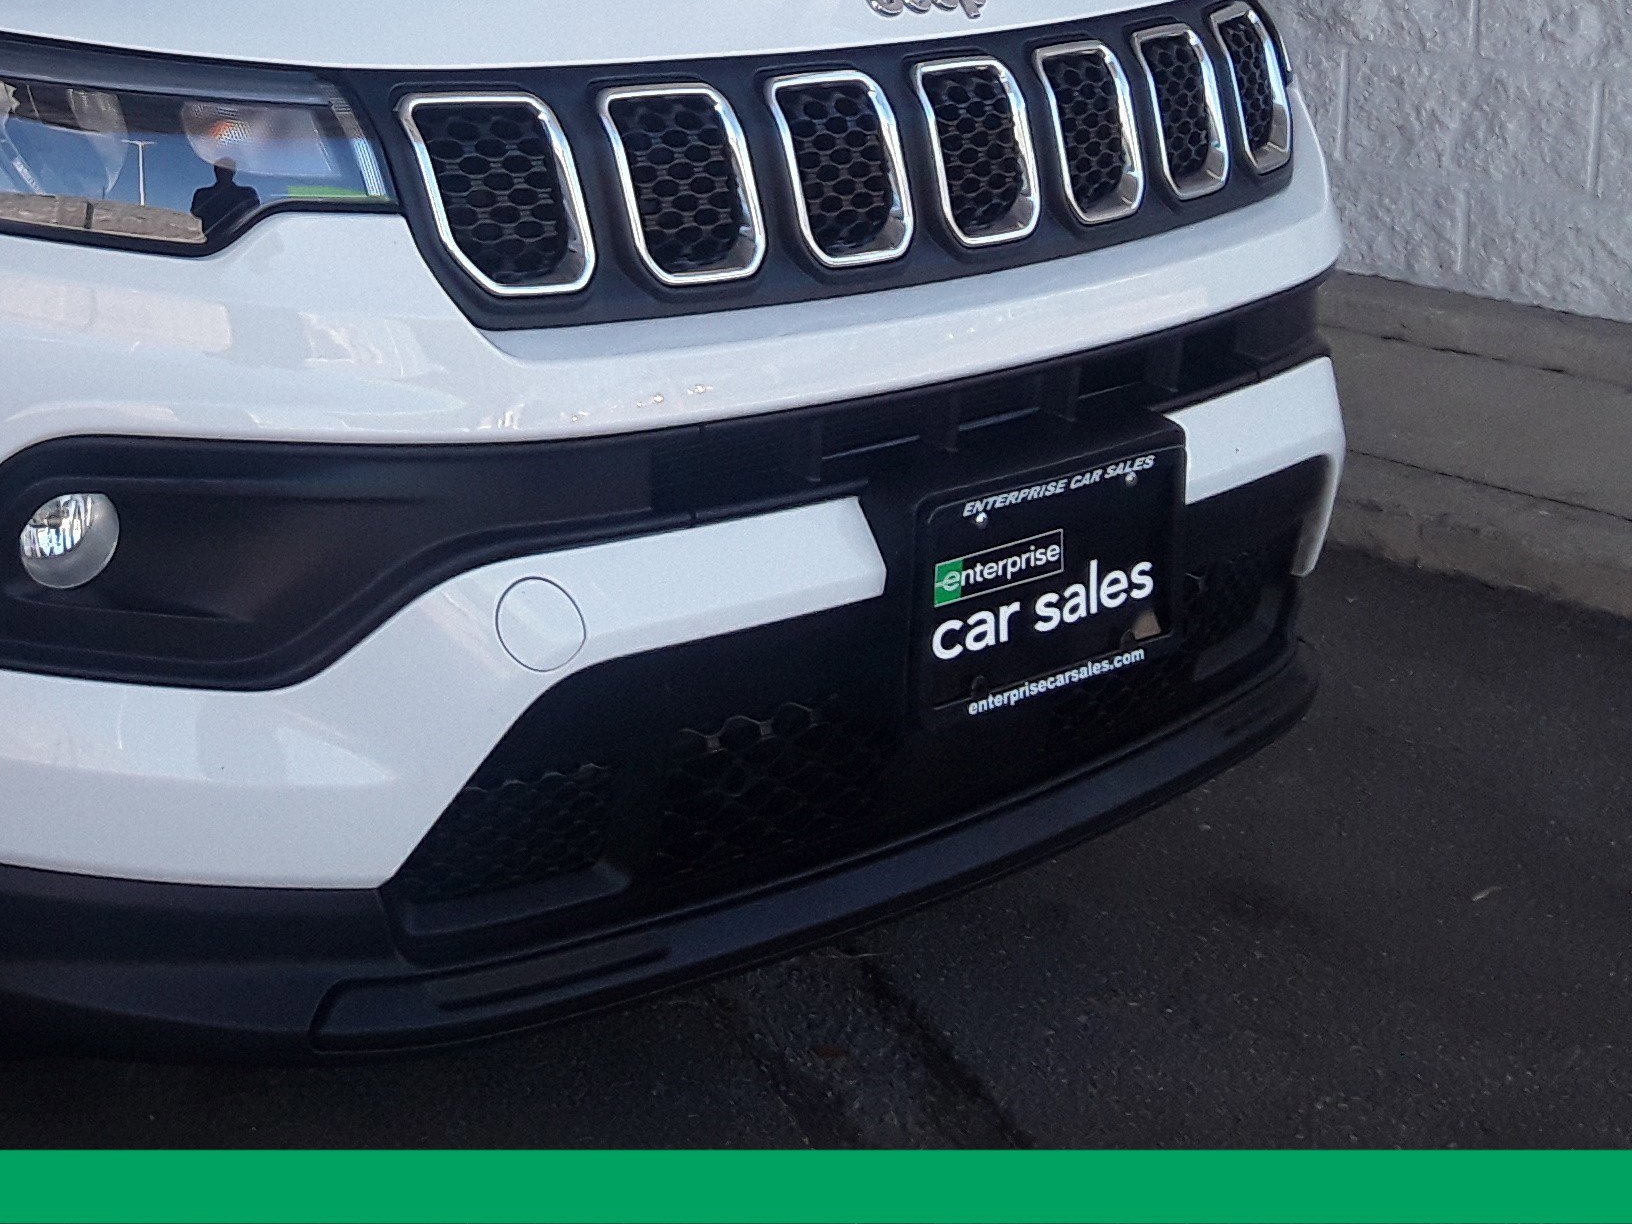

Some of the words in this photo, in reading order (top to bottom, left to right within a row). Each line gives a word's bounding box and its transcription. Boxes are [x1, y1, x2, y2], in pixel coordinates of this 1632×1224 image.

[961, 478, 1069, 518] ENTERPRISE
[1069, 468, 1103, 490] CAR
[1104, 454, 1156, 479] SALES
[936, 542, 1061, 592] enterprise
[931, 601, 1021, 660] car
[1033, 559, 1155, 633] sales
[968, 648, 1146, 716] enterprisecarsales.com
